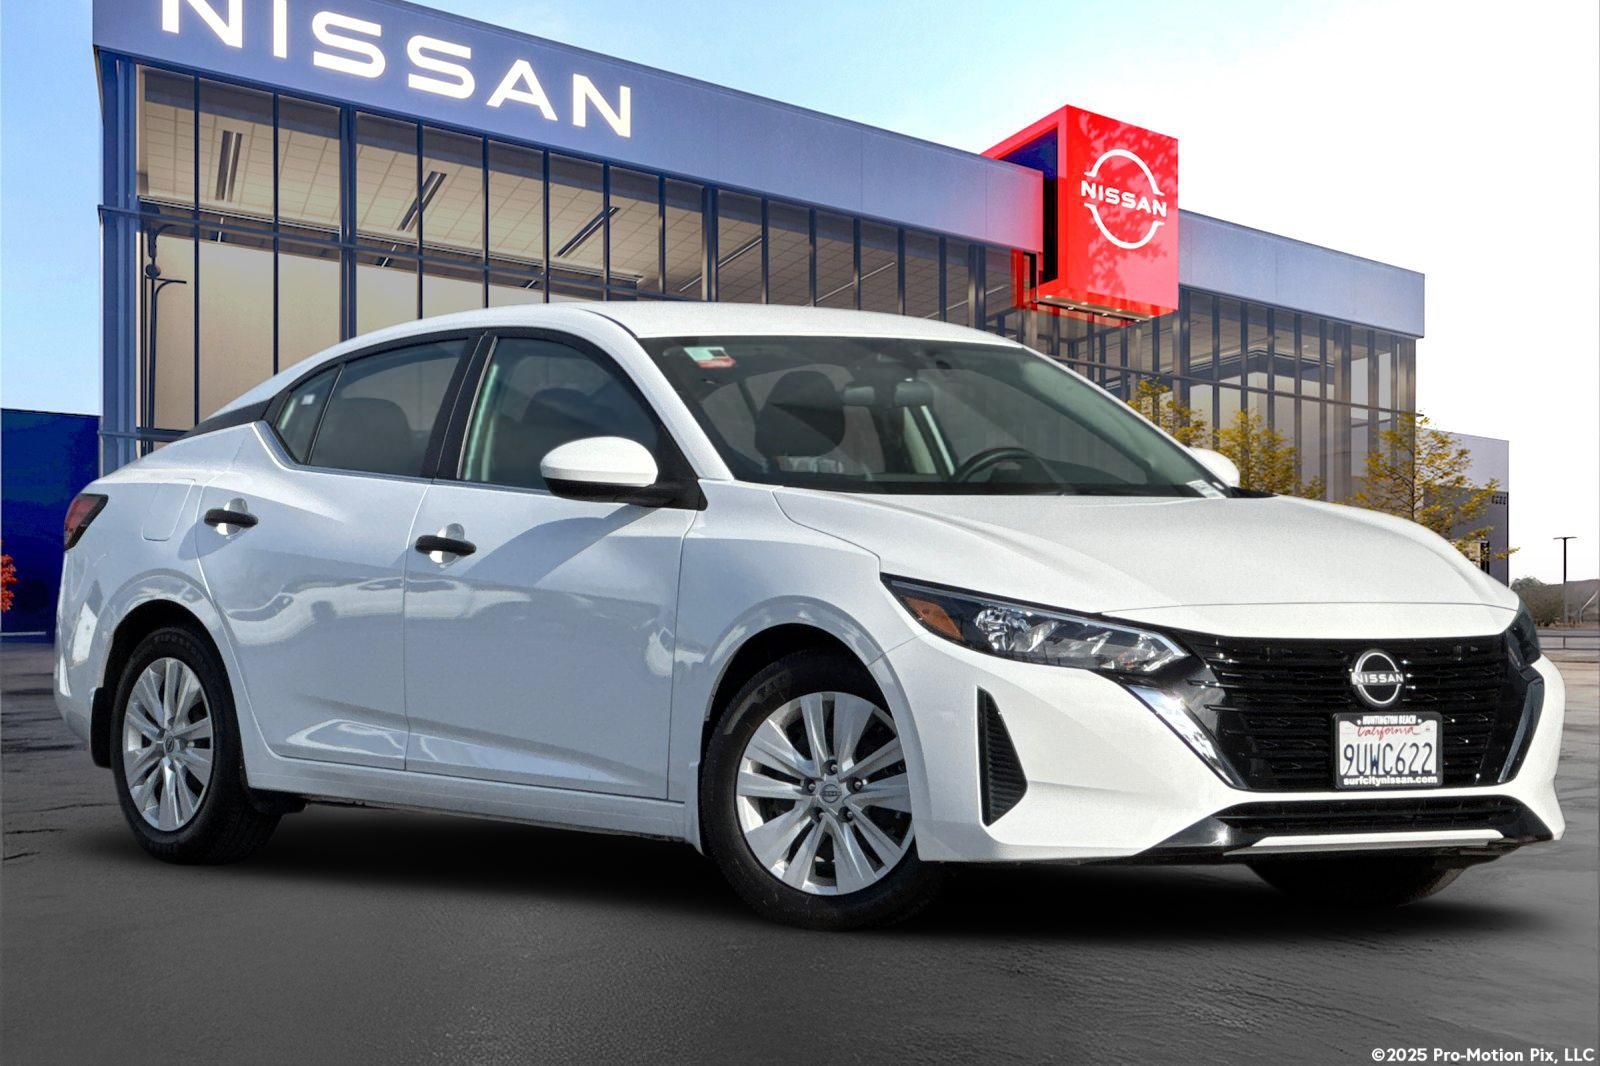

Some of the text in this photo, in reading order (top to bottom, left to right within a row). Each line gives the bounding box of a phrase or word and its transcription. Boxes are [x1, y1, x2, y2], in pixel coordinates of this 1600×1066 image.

[162, 0, 632, 138] NISSAN
[1081, 180, 1167, 217] NISSAN
[1352, 673, 1403, 684] NISSAN
[1357, 726, 1420, 741] California
[1343, 742, 1432, 776] 9UWC622
[1343, 775, 1438, 786] surfcitynissan.com
